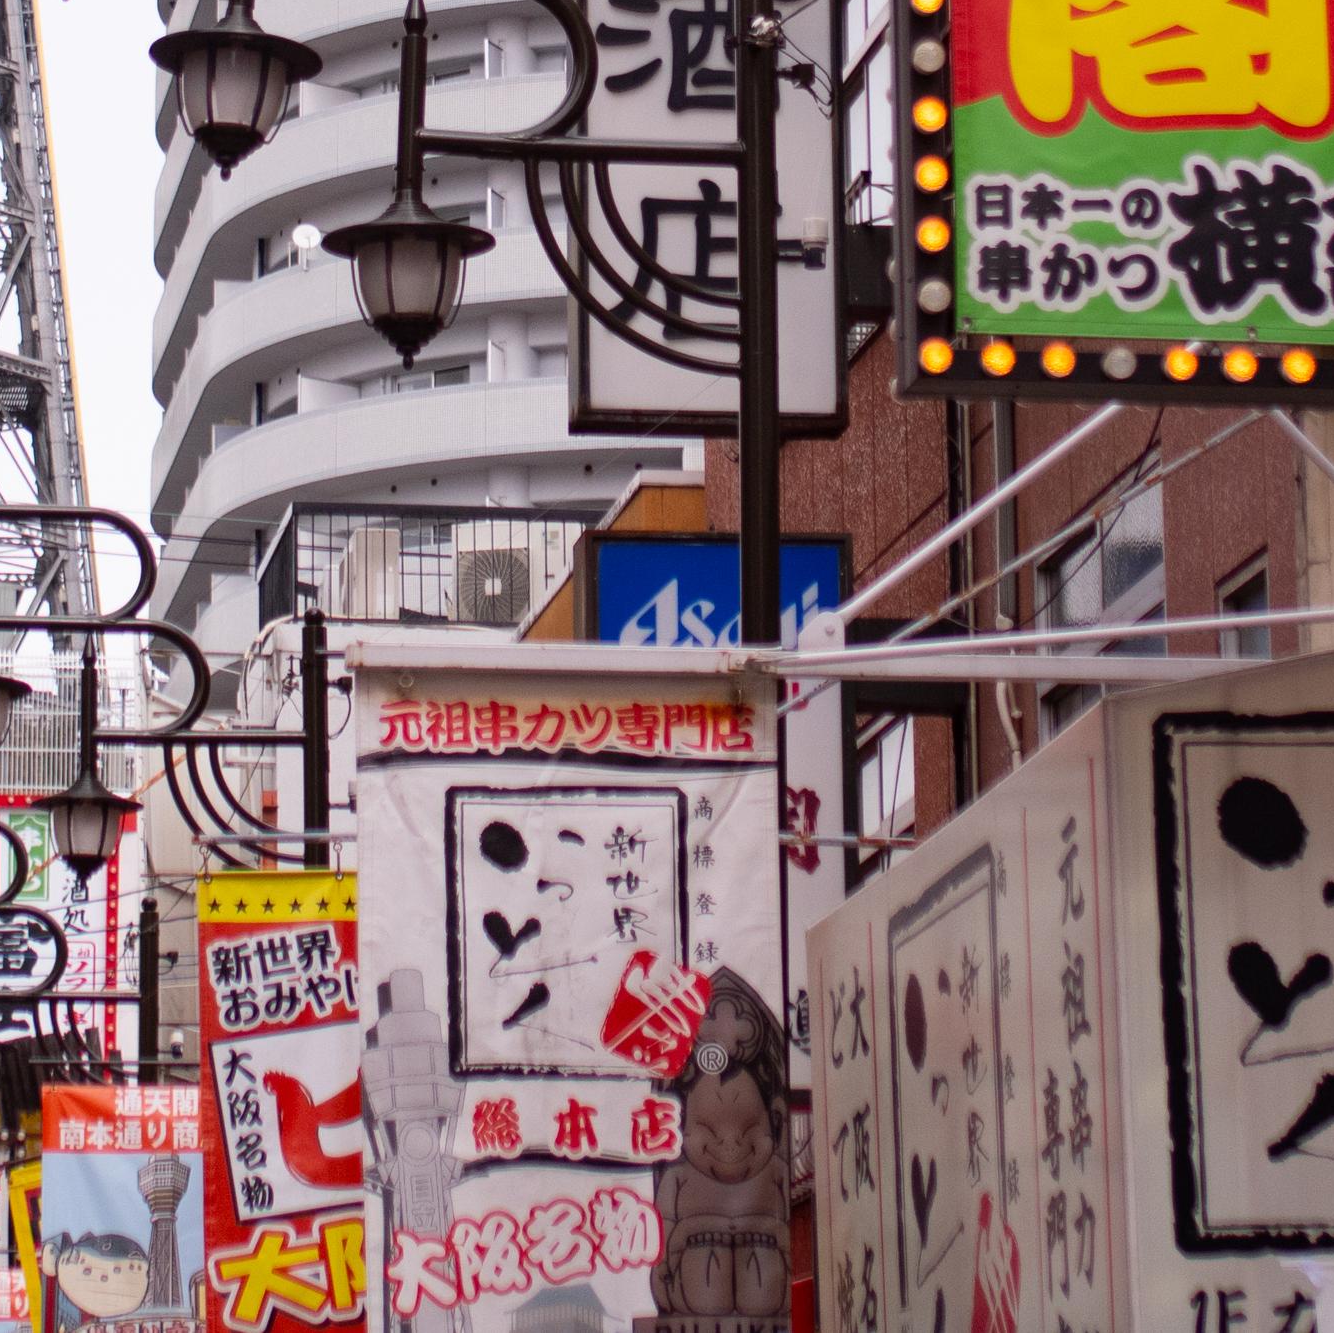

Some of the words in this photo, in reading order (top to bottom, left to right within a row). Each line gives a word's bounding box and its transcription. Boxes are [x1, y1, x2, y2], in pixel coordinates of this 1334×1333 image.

[973, 182, 1162, 229] 日本一の
[978, 243, 1161, 302] 串かつ
[379, 700, 756, 755] 元祖串カツ専門店
[604, 824, 659, 943] 新世界
[693, 795, 720, 964] 商標登録
[212, 929, 336, 987] 新世界
[115, 1087, 199, 1118] 通天閣
[1057, 816, 1098, 1333] 元祖串カ
[59, 1119, 204, 1151] 南本通り商
[222, 1047, 274, 1213] 大阪名物
[473, 1097, 682, 1159] 総本店
[1041, 1067, 1072, 1333] 専門
[389, 1187, 665, 1319] 大阪名物
